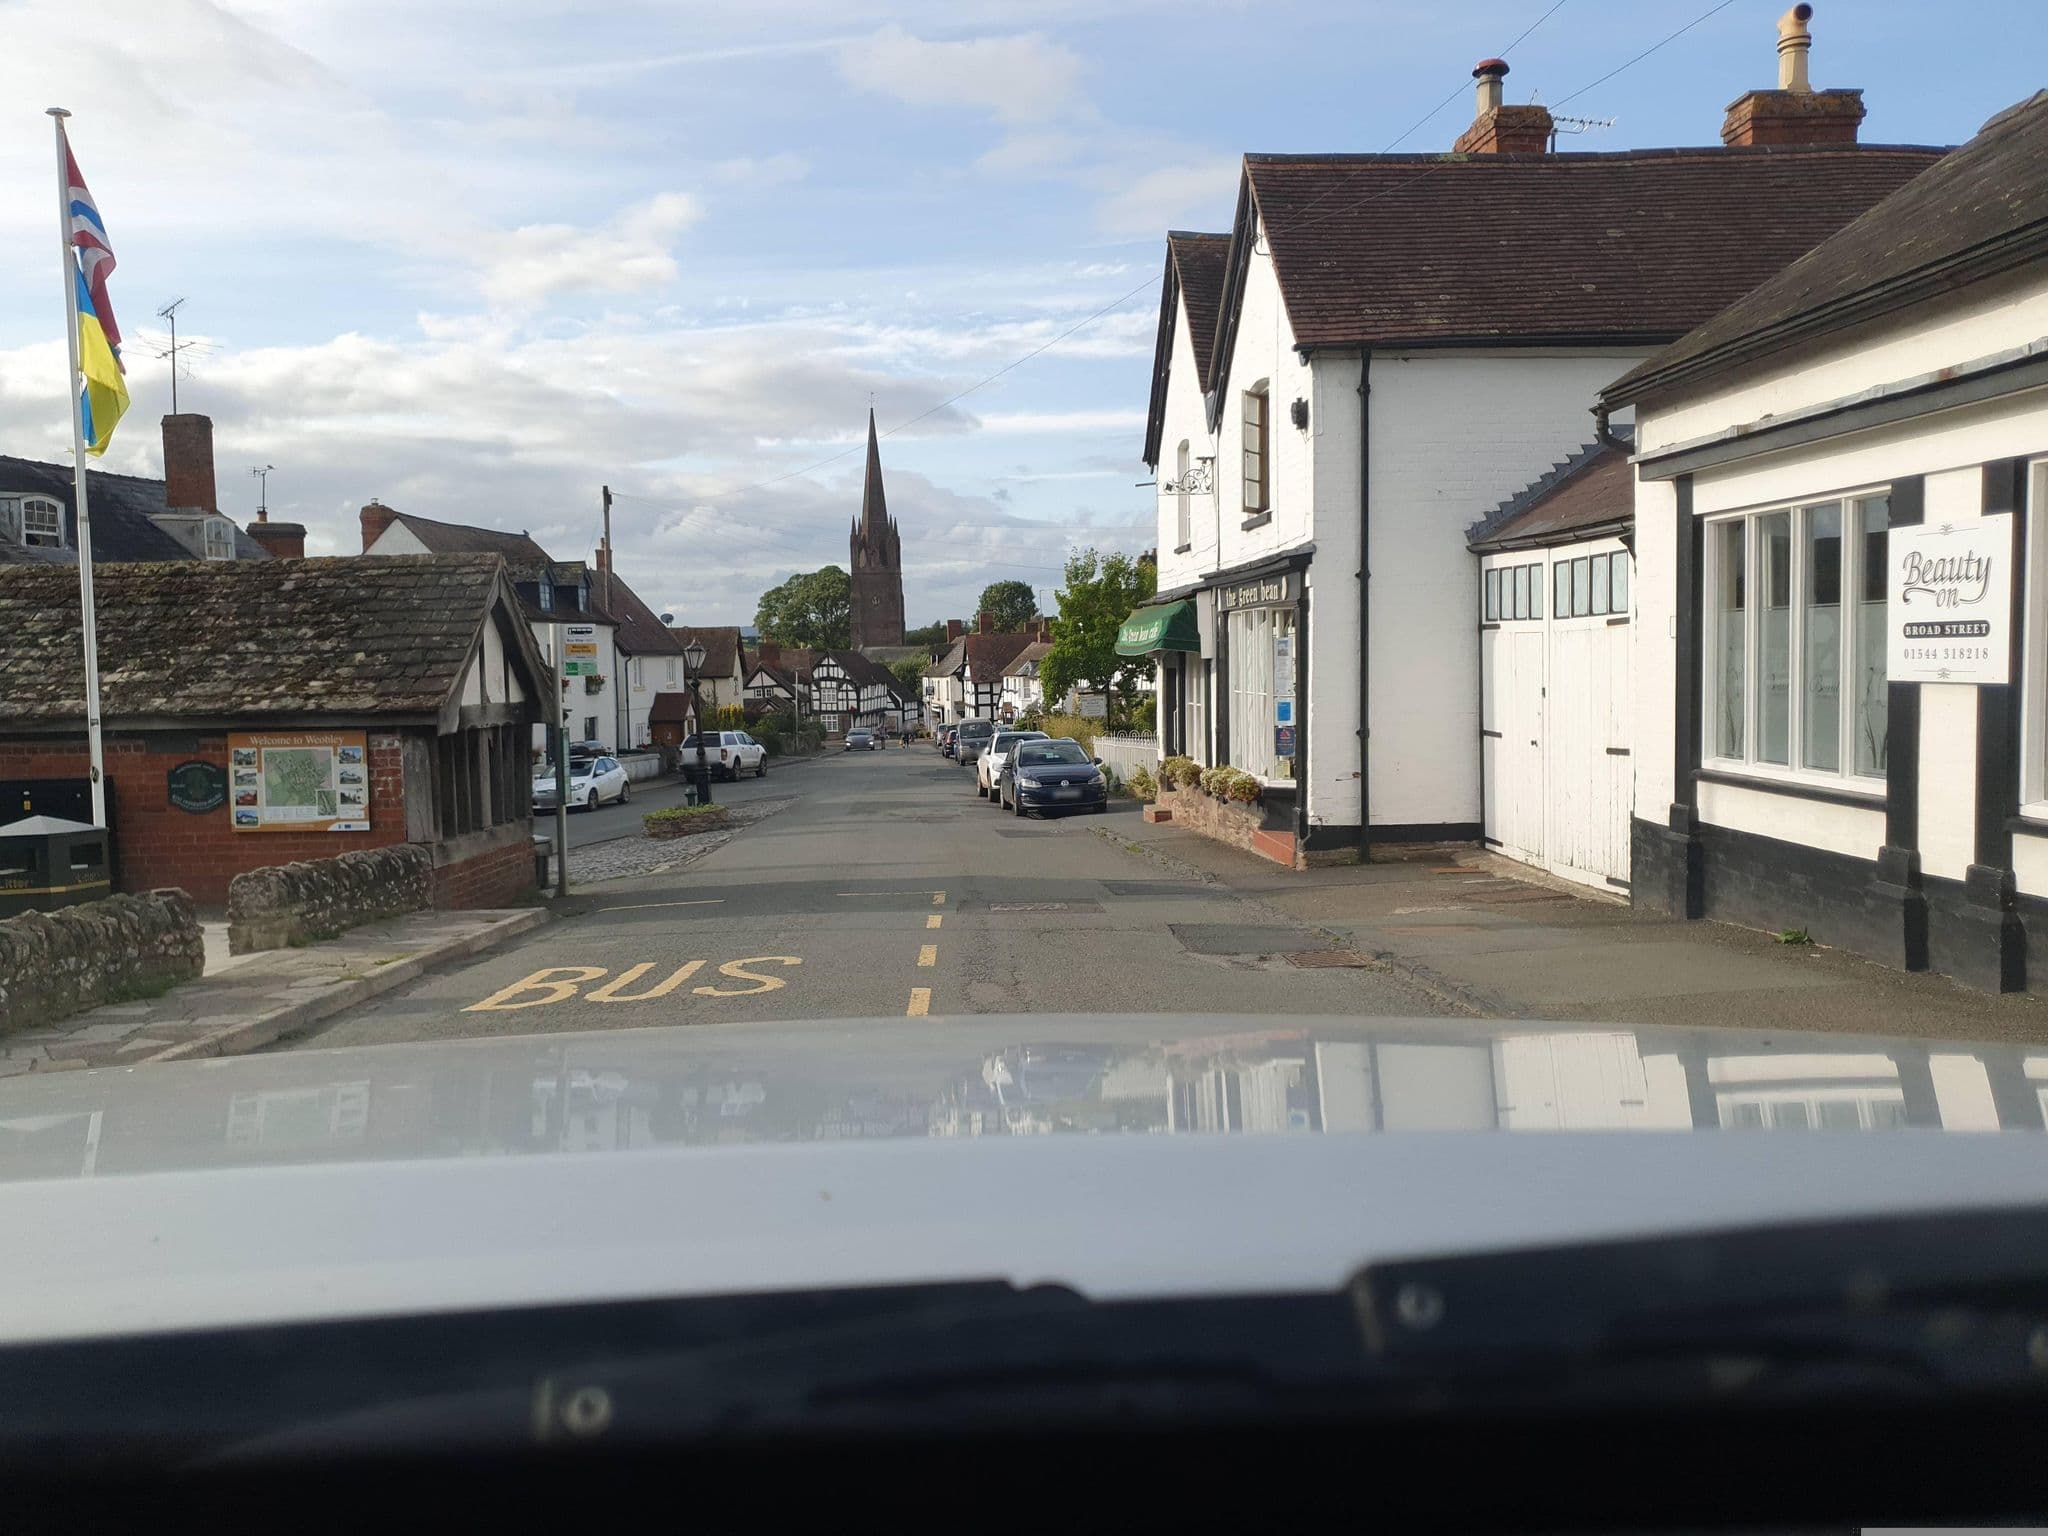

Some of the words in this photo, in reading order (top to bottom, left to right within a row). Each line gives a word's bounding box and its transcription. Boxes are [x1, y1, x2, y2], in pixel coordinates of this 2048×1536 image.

[1902, 550, 1992, 604] Beauty
[1225, 587, 1237, 607] the
[1239, 587, 1258, 607] green
[1260, 579, 1278, 600] bean
[1936, 586, 1960, 609] on
[1904, 624, 1942, 636] BROAD
[1944, 623, 1988, 634] STREET
[1903, 649, 1938, 660] 01544
[1943, 648, 1989, 660] 318218
[249, 735, 291, 746] Welcome
[293, 736, 303, 745] to
[460, 956, 802, 1012] BUS
